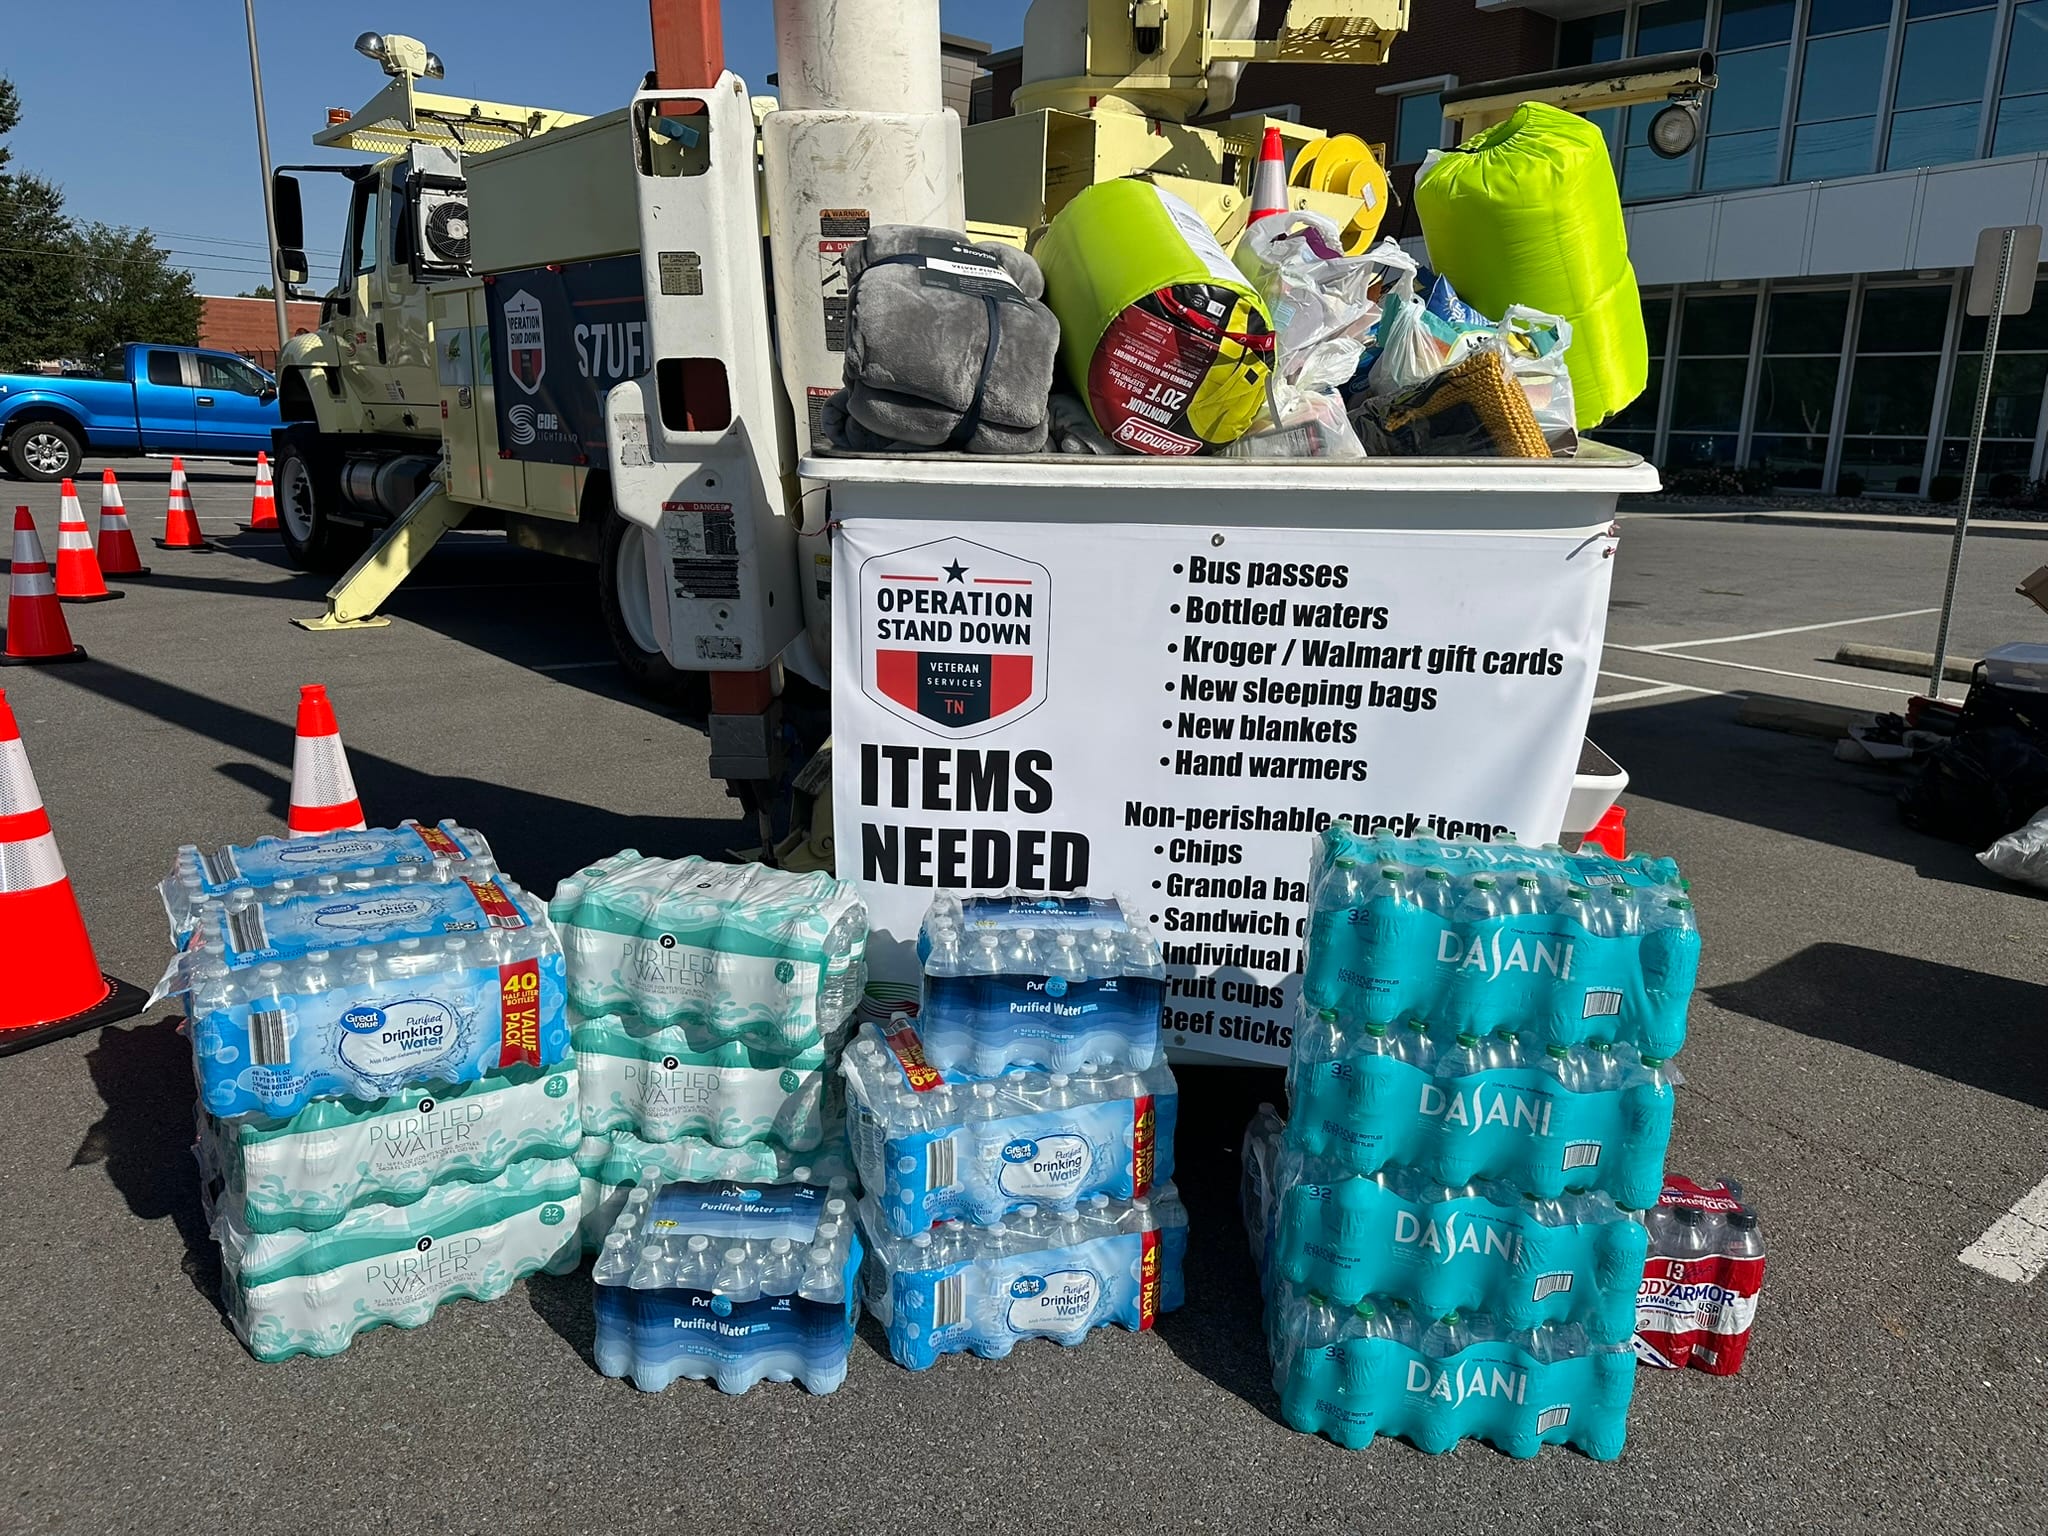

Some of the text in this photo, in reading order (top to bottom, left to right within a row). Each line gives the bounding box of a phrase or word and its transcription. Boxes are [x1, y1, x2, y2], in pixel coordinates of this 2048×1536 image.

[832, 210, 866, 218] WARNING
[1113, 348, 1137, 364] COMFORT
[1114, 378, 1126, 389] TALL
[1120, 374, 1146, 389] SLEEPING
[1144, 383, 1188, 411] 20°F
[1133, 429, 1192, 456] Coleman
[1188, 556, 1349, 588] Bus passes
[877, 588, 1033, 618] OPERATION
[1186, 596, 1389, 630] Bottled waters
[877, 618, 1031, 645] STAND DOWN
[1183, 635, 1564, 676] Kroger / Walmart gift cards
[930, 662, 980, 674] VETERAN
[927, 677, 983, 688] SERVICES
[1180, 675, 1438, 712] New sleeping bags
[944, 699, 964, 714] TN
[1177, 713, 1358, 743] New blankets
[1175, 750, 1368, 781] Hand warmers
[860, 743, 1053, 814] ITEMS
[1124, 801, 1332, 833] Non-perishable
[860, 822, 1090, 892] NEEDED
[1169, 838, 1243, 866] Chips
[1440, 846, 1555, 869] DASANI
[1166, 873, 1310, 902] Granola ba
[1164, 907, 1290, 937] Sandwich
[1347, 908, 1370, 921] 32
[623, 943, 715, 975] PURIFIED
[1162, 942, 1291, 973] Individual
[1437, 926, 1575, 983] DASANI
[504, 972, 537, 992] 40
[632, 960, 705, 988] WATER
[503, 989, 539, 1001] HALF LITER
[1026, 981, 1044, 991] Pur
[1221, 980, 1284, 1009] cups
[506, 995, 536, 1006] BOTTLES
[1010, 1001, 1081, 1017] Purified Water
[345, 1012, 378, 1023] Great
[353, 1019, 379, 1029] Value
[406, 1012, 443, 1026] Purified
[1161, 1006, 1293, 1049] Beef sticks
[382, 1024, 443, 1044] Drinking
[505, 1012, 521, 1047] PACK
[521, 1008, 537, 1052] VALUE
[400, 1035, 444, 1051] Water
[624, 1065, 720, 1091] PURIFIED
[783, 1074, 795, 1085] 32
[1331, 1062, 1353, 1076] 32
[272, 1081, 295, 1090] BOTTLES
[549, 1079, 563, 1090] 32
[636, 1083, 710, 1105] WATER
[1419, 1081, 1553, 1136] DASANI
[369, 1103, 484, 1146] PURIFIED
[384, 1123, 472, 1159] WATER
[1004, 1144, 1032, 1155] Great
[1033, 1156, 1082, 1173] Drinking
[1049, 1167, 1082, 1182] Water
[1135, 1148, 1147, 1187] PACK
[721, 1189, 739, 1197] Pur
[1308, 1185, 1333, 1199] 32
[544, 1207, 559, 1217] 32
[700, 1202, 775, 1214] Purified Water
[1394, 1210, 1523, 1265] DASANI
[366, 1237, 482, 1284] PURIFIED
[1665, 1262, 1685, 1280] 13
[383, 1256, 469, 1295] WATER
[692, 1296, 710, 1307] Pur
[1041, 1290, 1090, 1307] Drinking
[1142, 1281, 1154, 1320] PACK
[1636, 1295, 1682, 1308] ortWater
[1637, 1281, 1735, 1307] ODYARMOR
[1056, 1302, 1089, 1316] Water
[1698, 1302, 1719, 1314] USA
[673, 1317, 750, 1337] Purified Water
[1325, 1345, 1346, 1360] 32
[1406, 1358, 1527, 1410] DASANI
